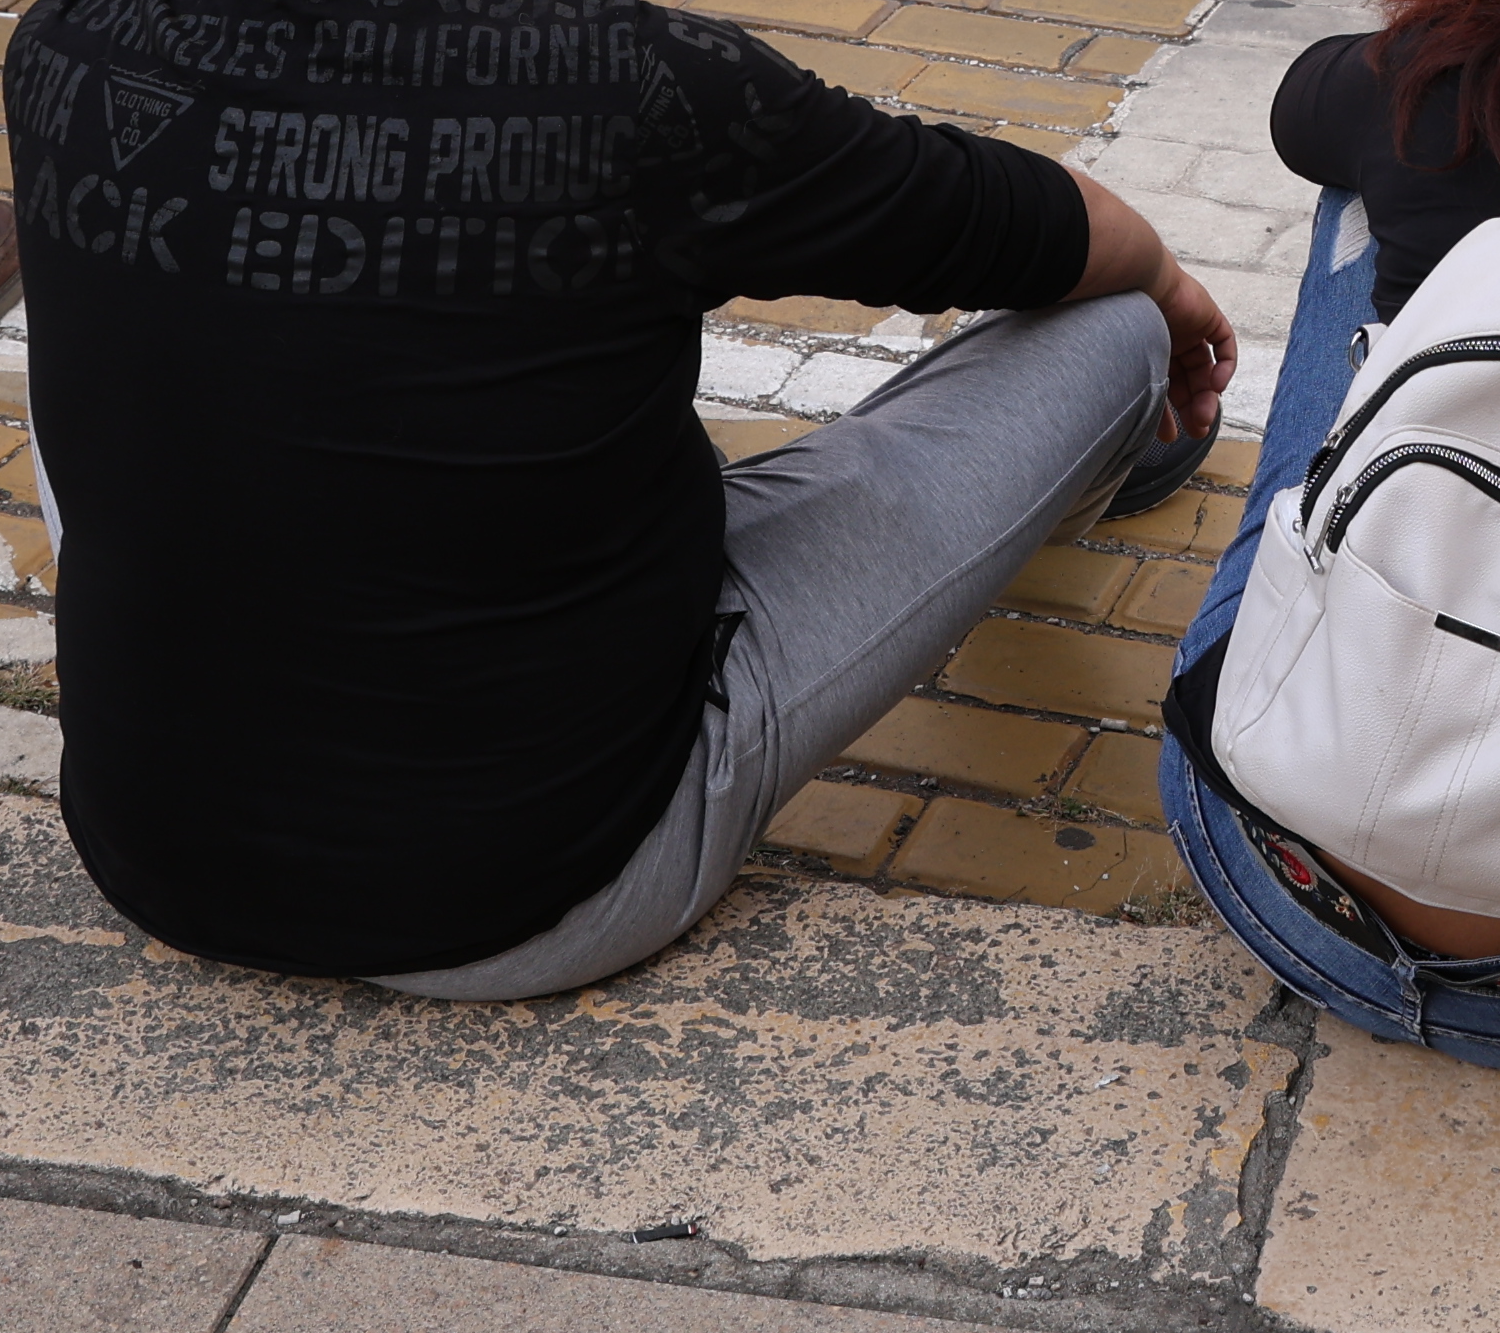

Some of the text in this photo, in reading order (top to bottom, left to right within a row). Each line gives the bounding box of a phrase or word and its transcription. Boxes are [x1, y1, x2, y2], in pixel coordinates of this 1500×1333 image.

[11, 36, 90, 145] XTRA
[305, 19, 638, 88] CALIFORNIA
[114, 89, 173, 118] CLOTHING
[129, 110, 140, 128] &
[208, 105, 412, 203] STRONG
[20, 155, 189, 273] ACK
